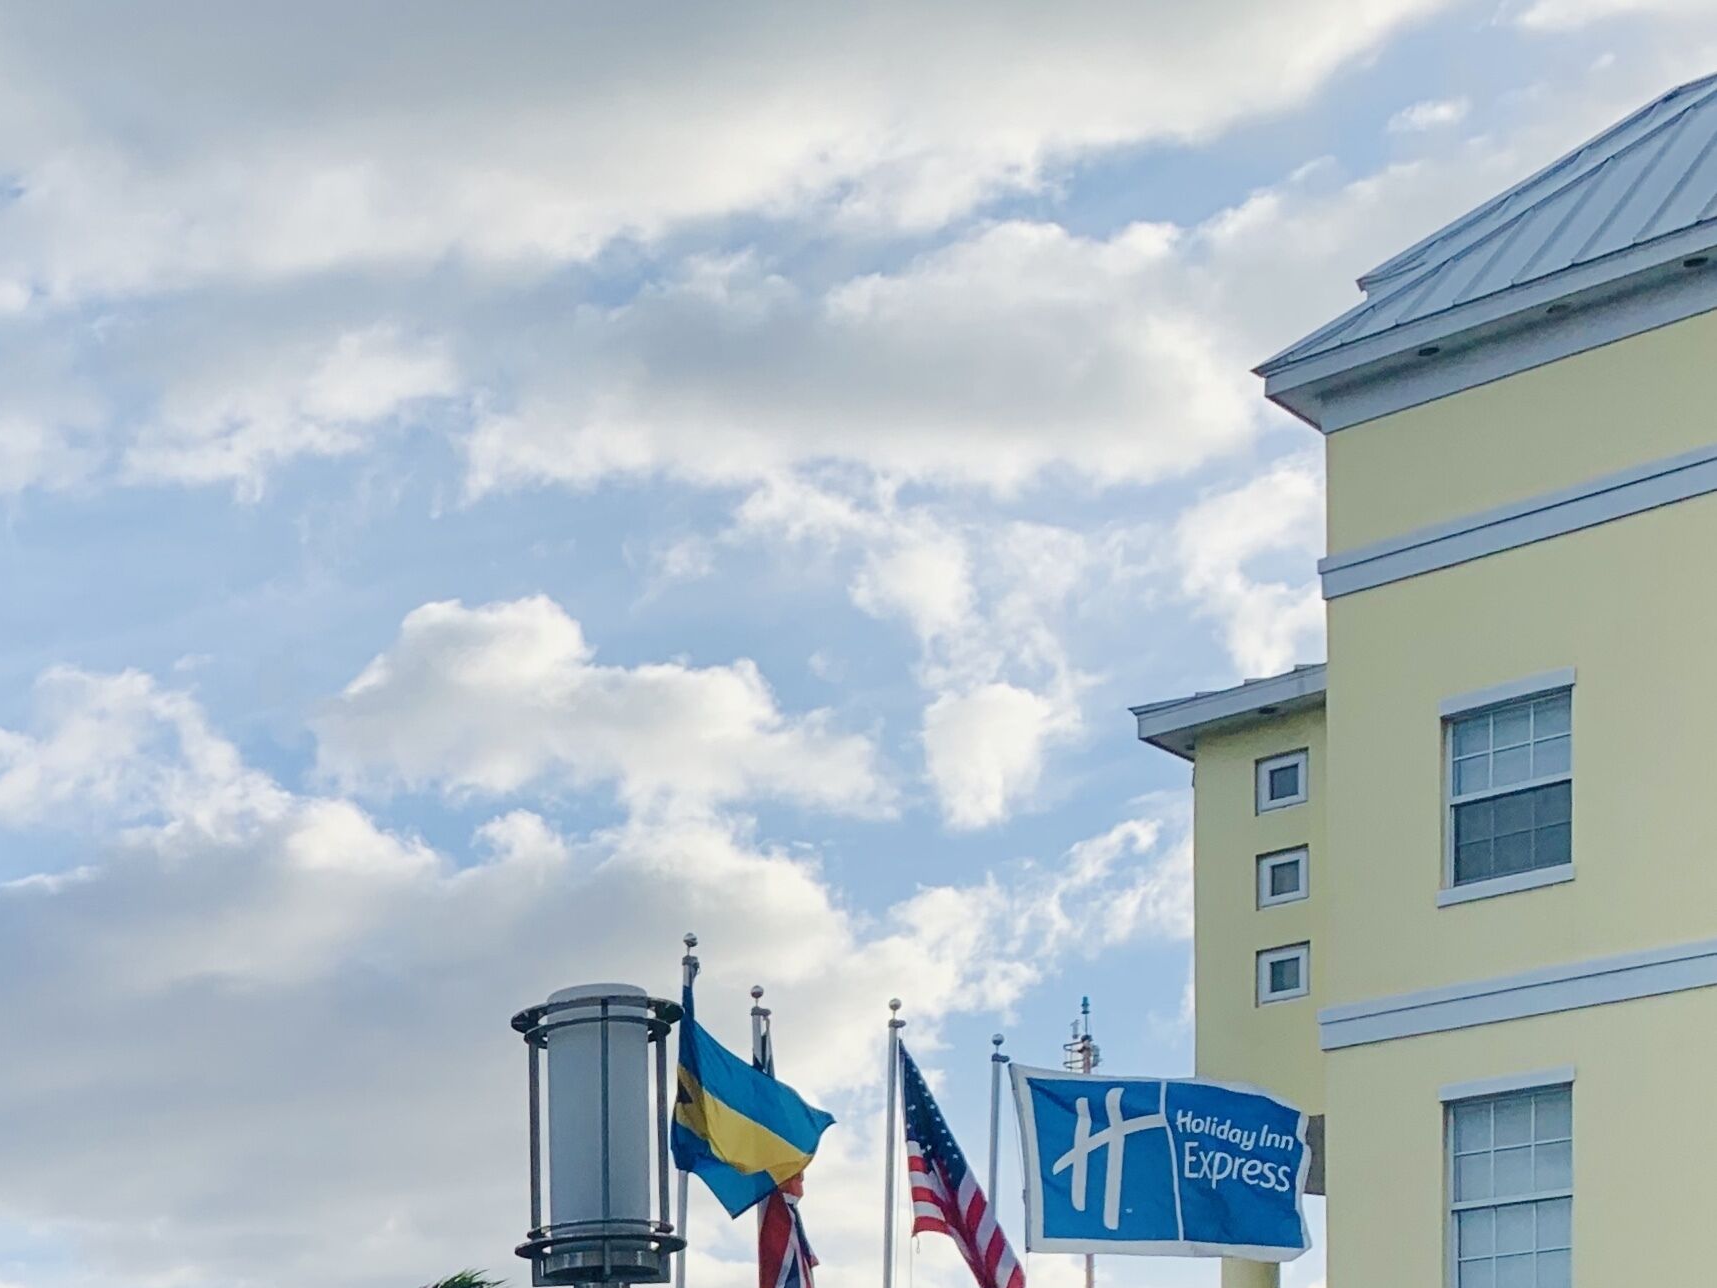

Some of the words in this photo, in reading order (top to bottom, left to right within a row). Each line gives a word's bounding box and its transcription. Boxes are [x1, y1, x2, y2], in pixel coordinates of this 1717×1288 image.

[1176, 1109, 1258, 1151] Holiday
[1259, 1125, 1295, 1152] Inn
[1184, 1141, 1292, 1193] Express
